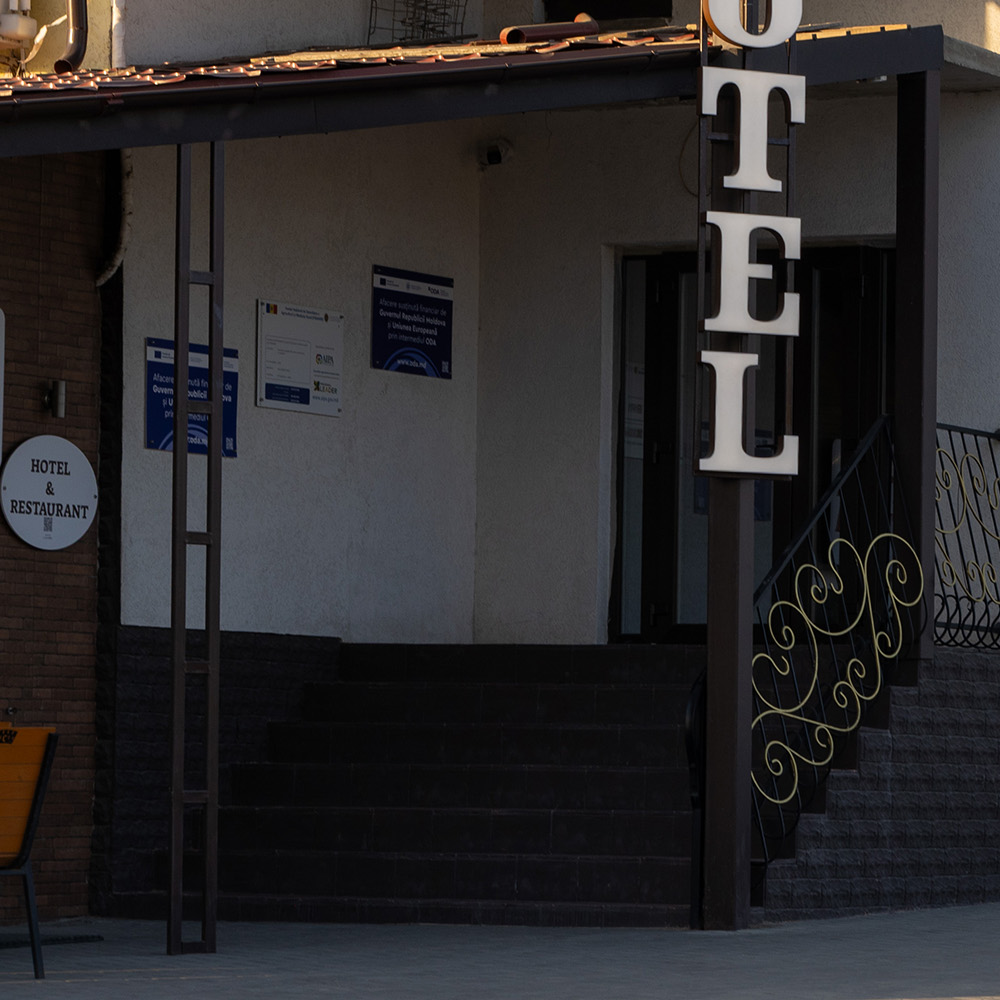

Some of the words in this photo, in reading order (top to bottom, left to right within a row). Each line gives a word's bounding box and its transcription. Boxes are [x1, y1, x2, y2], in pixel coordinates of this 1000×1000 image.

[379, 298, 397, 308] Afacere
[379, 309, 401, 319] Guvernul
[402, 312, 425, 322] Republicii
[426, 317, 446, 326] Moldova
[392, 322, 412, 331] Uniunea
[425, 337, 437, 346] ODA
[396, 359, 427, 369] www.oda.md
[153, 385, 174, 395] Guvern
[225, 383, 232, 391] de
[319, 385, 338, 394] LEADER
[31, 458, 70, 475] HOTEL
[45, 481, 54, 496] &
[10, 499, 88, 519] RESTAURANT
